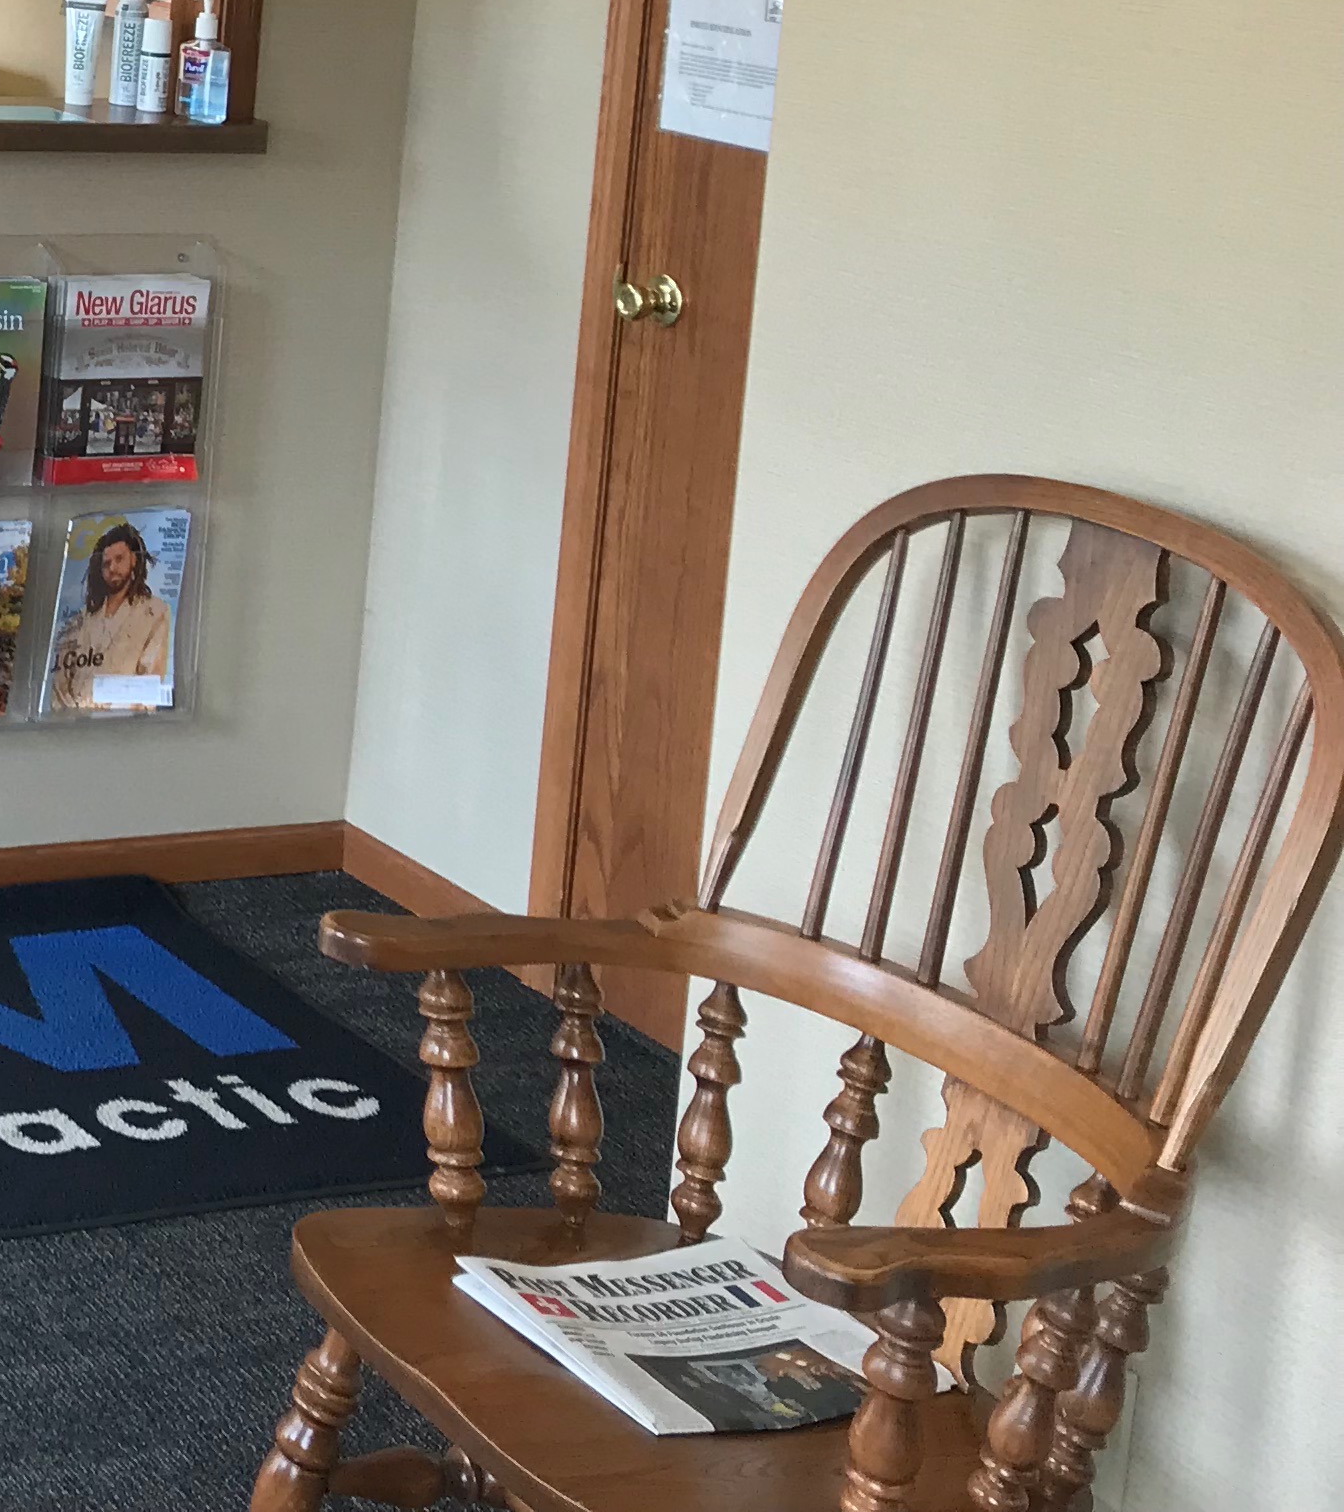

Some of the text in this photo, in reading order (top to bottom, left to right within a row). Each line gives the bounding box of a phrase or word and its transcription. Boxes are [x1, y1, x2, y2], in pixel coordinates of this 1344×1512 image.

[73, 12, 90, 71] BIOFREZE
[120, 22, 137, 83] BIOFREEZE
[76, 289, 198, 316] New Glarus
[63, 646, 104, 669] Cole
[487, 1259, 759, 1299] POST MESSENGER
[568, 1292, 742, 1324] RECORDER
